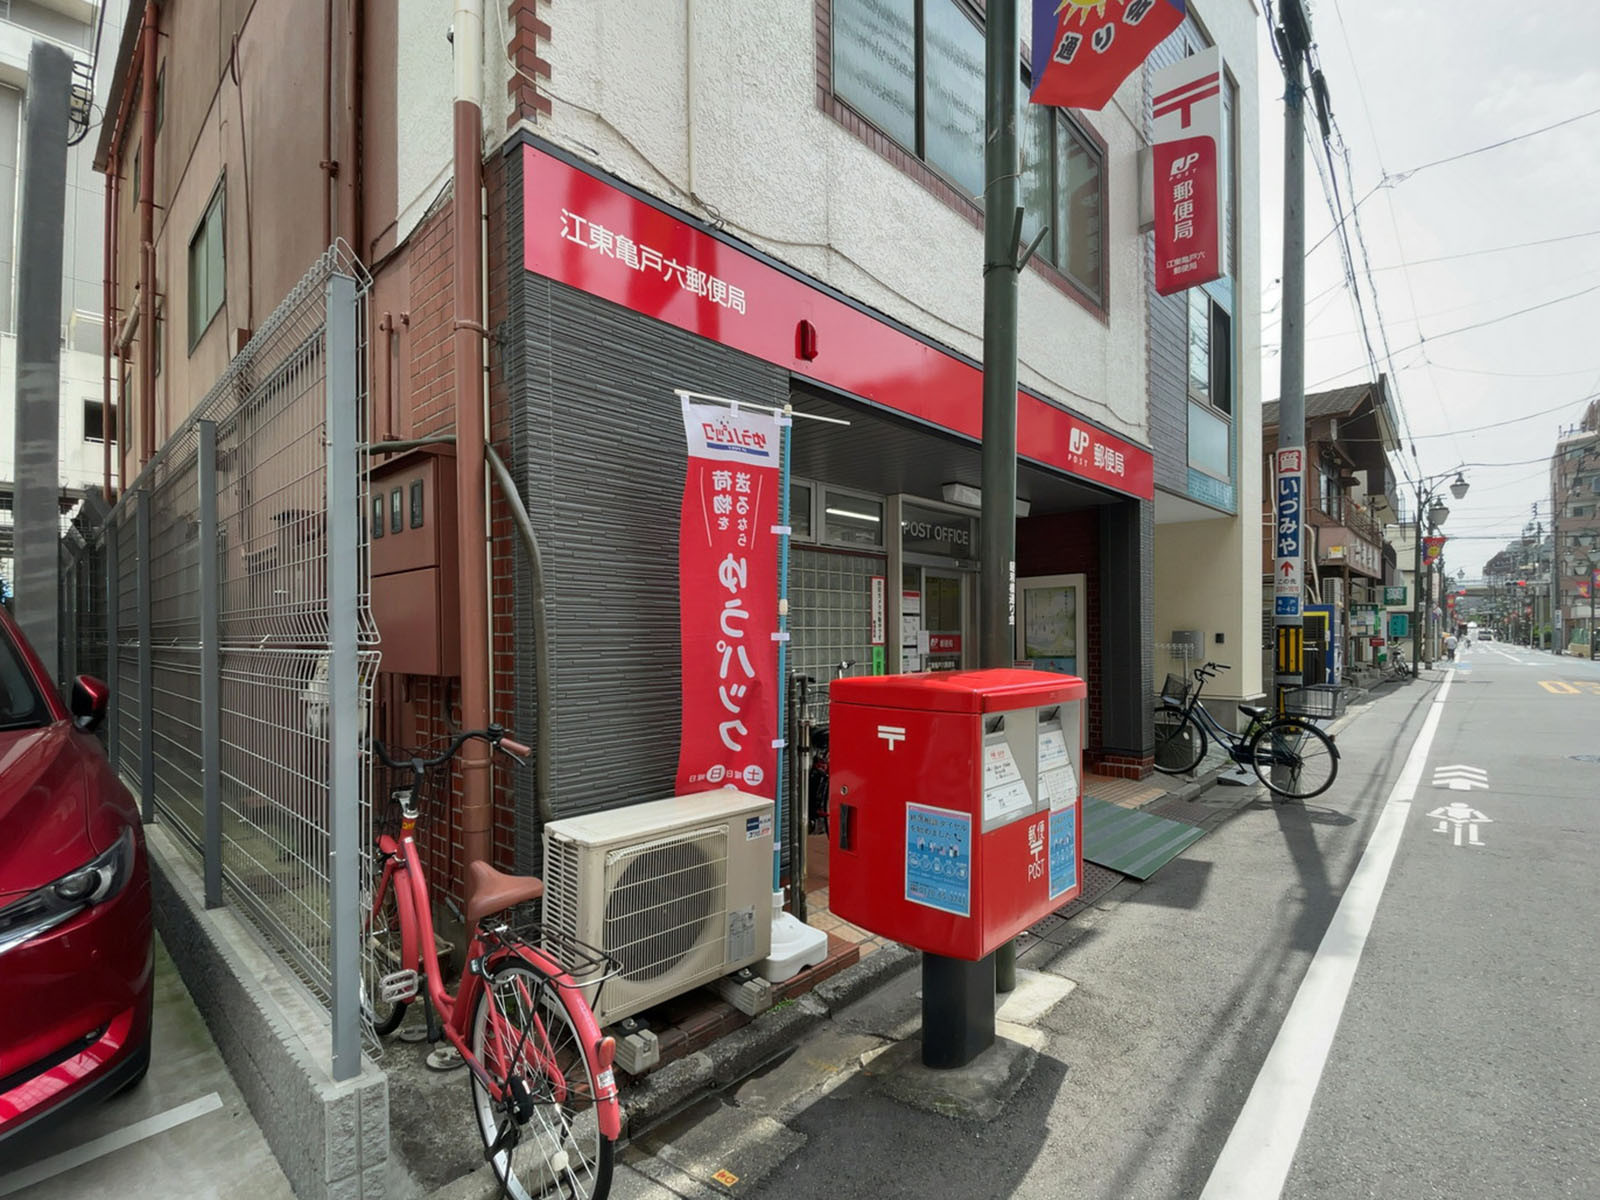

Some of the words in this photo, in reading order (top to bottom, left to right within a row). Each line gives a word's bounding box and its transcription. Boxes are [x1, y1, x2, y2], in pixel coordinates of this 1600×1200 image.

[1173, 179, 1195, 242] 郵便局
[559, 207, 747, 315] 江東亀戸六郵便局
[1069, 427, 1090, 456] JP
[1093, 442, 1125, 477] 郵便局
[1280, 451, 1300, 473] 質
[1279, 479, 1299, 556] いづみや
[902, 520, 932, 540] POST
[934, 525, 969, 545] OFFICE
[1028, 820, 1045, 846] 郵便
[1028, 859, 1046, 883] POST
